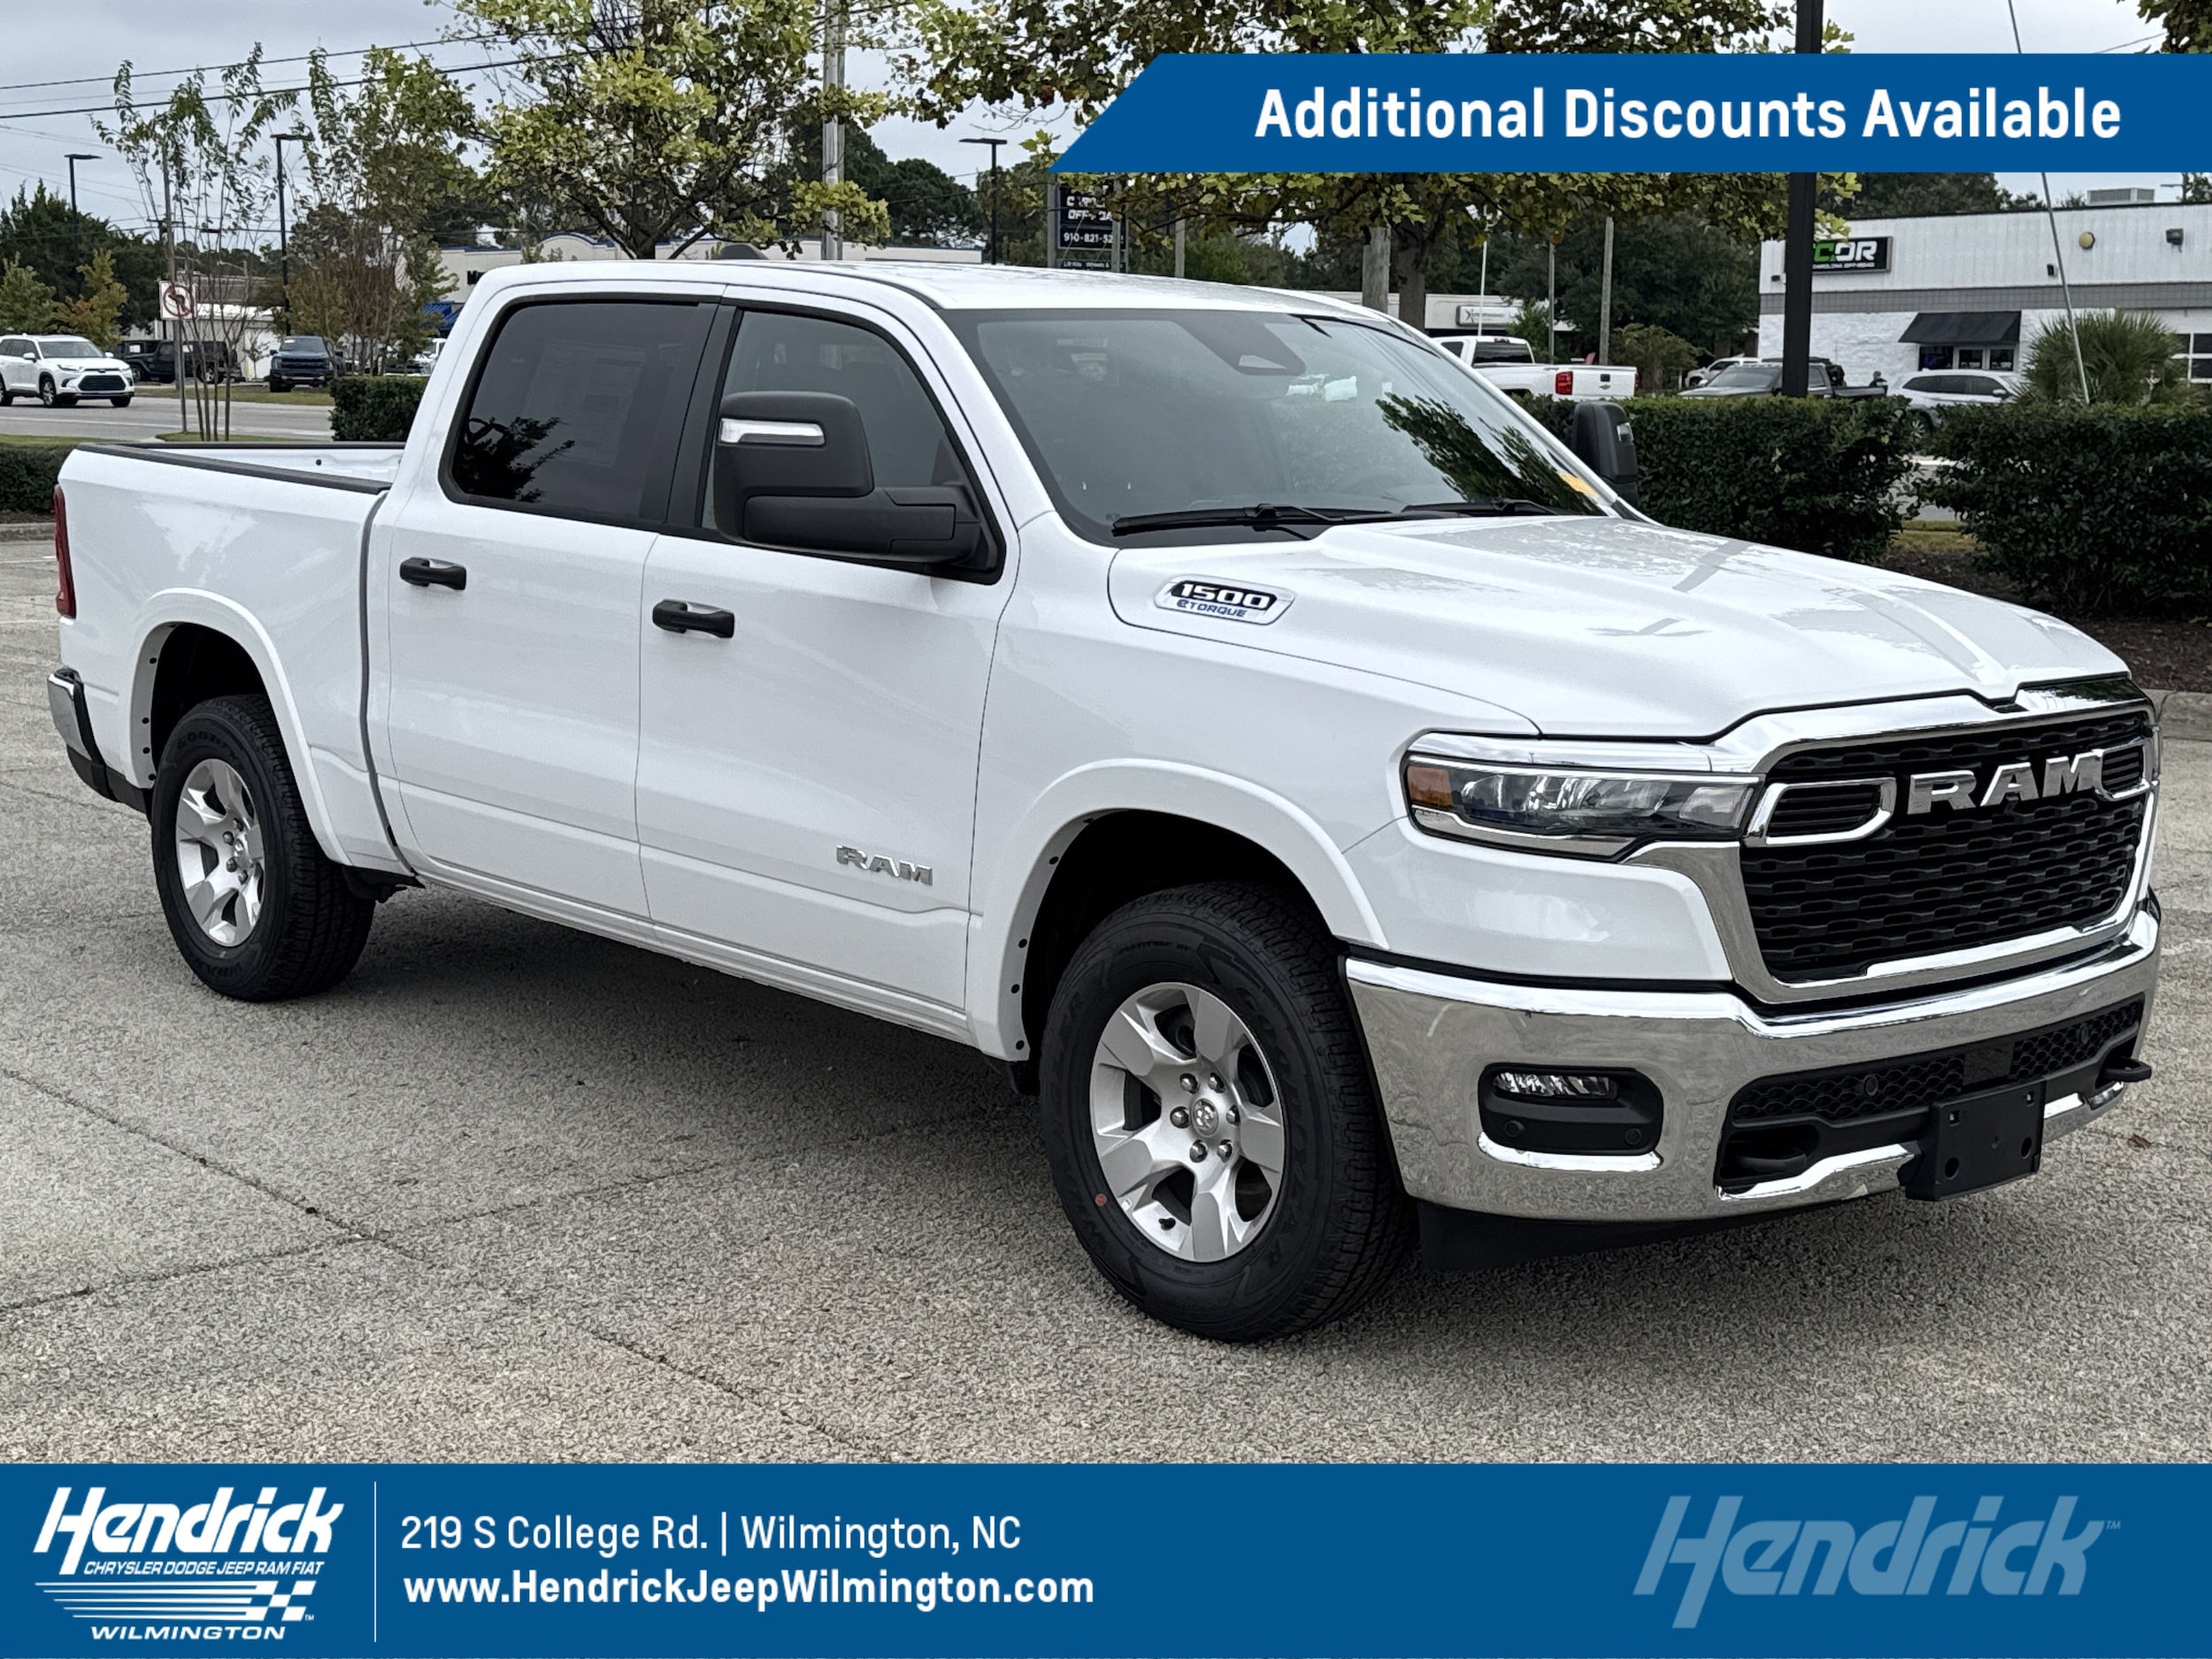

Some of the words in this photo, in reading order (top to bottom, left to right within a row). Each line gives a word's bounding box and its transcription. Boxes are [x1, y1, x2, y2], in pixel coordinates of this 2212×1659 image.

[1180, 582, 1271, 611] 1500
[1907, 749, 2102, 815] RAM
[836, 844, 933, 887] RAM
